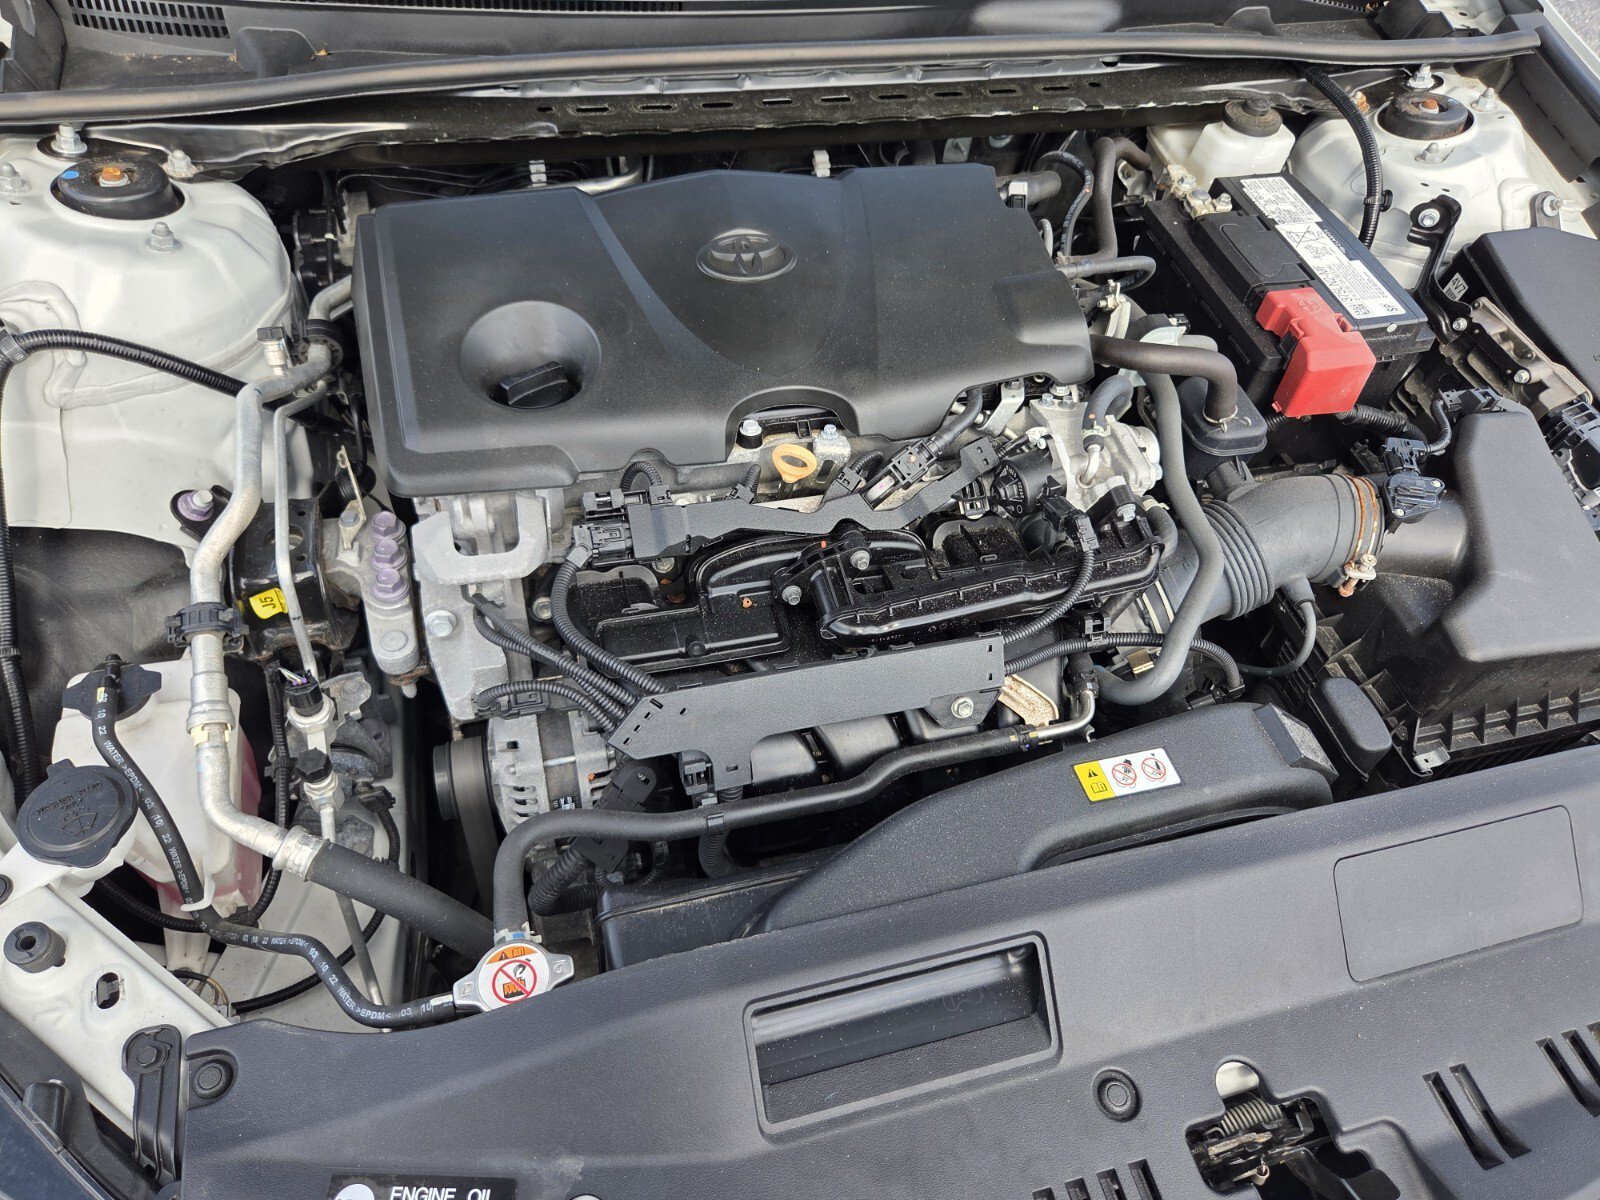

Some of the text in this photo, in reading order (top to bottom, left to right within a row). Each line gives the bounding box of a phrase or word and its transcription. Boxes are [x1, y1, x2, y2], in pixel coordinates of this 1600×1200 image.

[98, 725, 108, 736] 22
[103, 740, 125, 765] WATER
[161, 833, 172, 844] 22
[168, 846, 183, 872] WATER
[261, 936, 269, 945] 22
[328, 974, 339, 986] 22
[337, 986, 356, 1012] WATER
[390, 1186, 457, 1200] ENGINE
